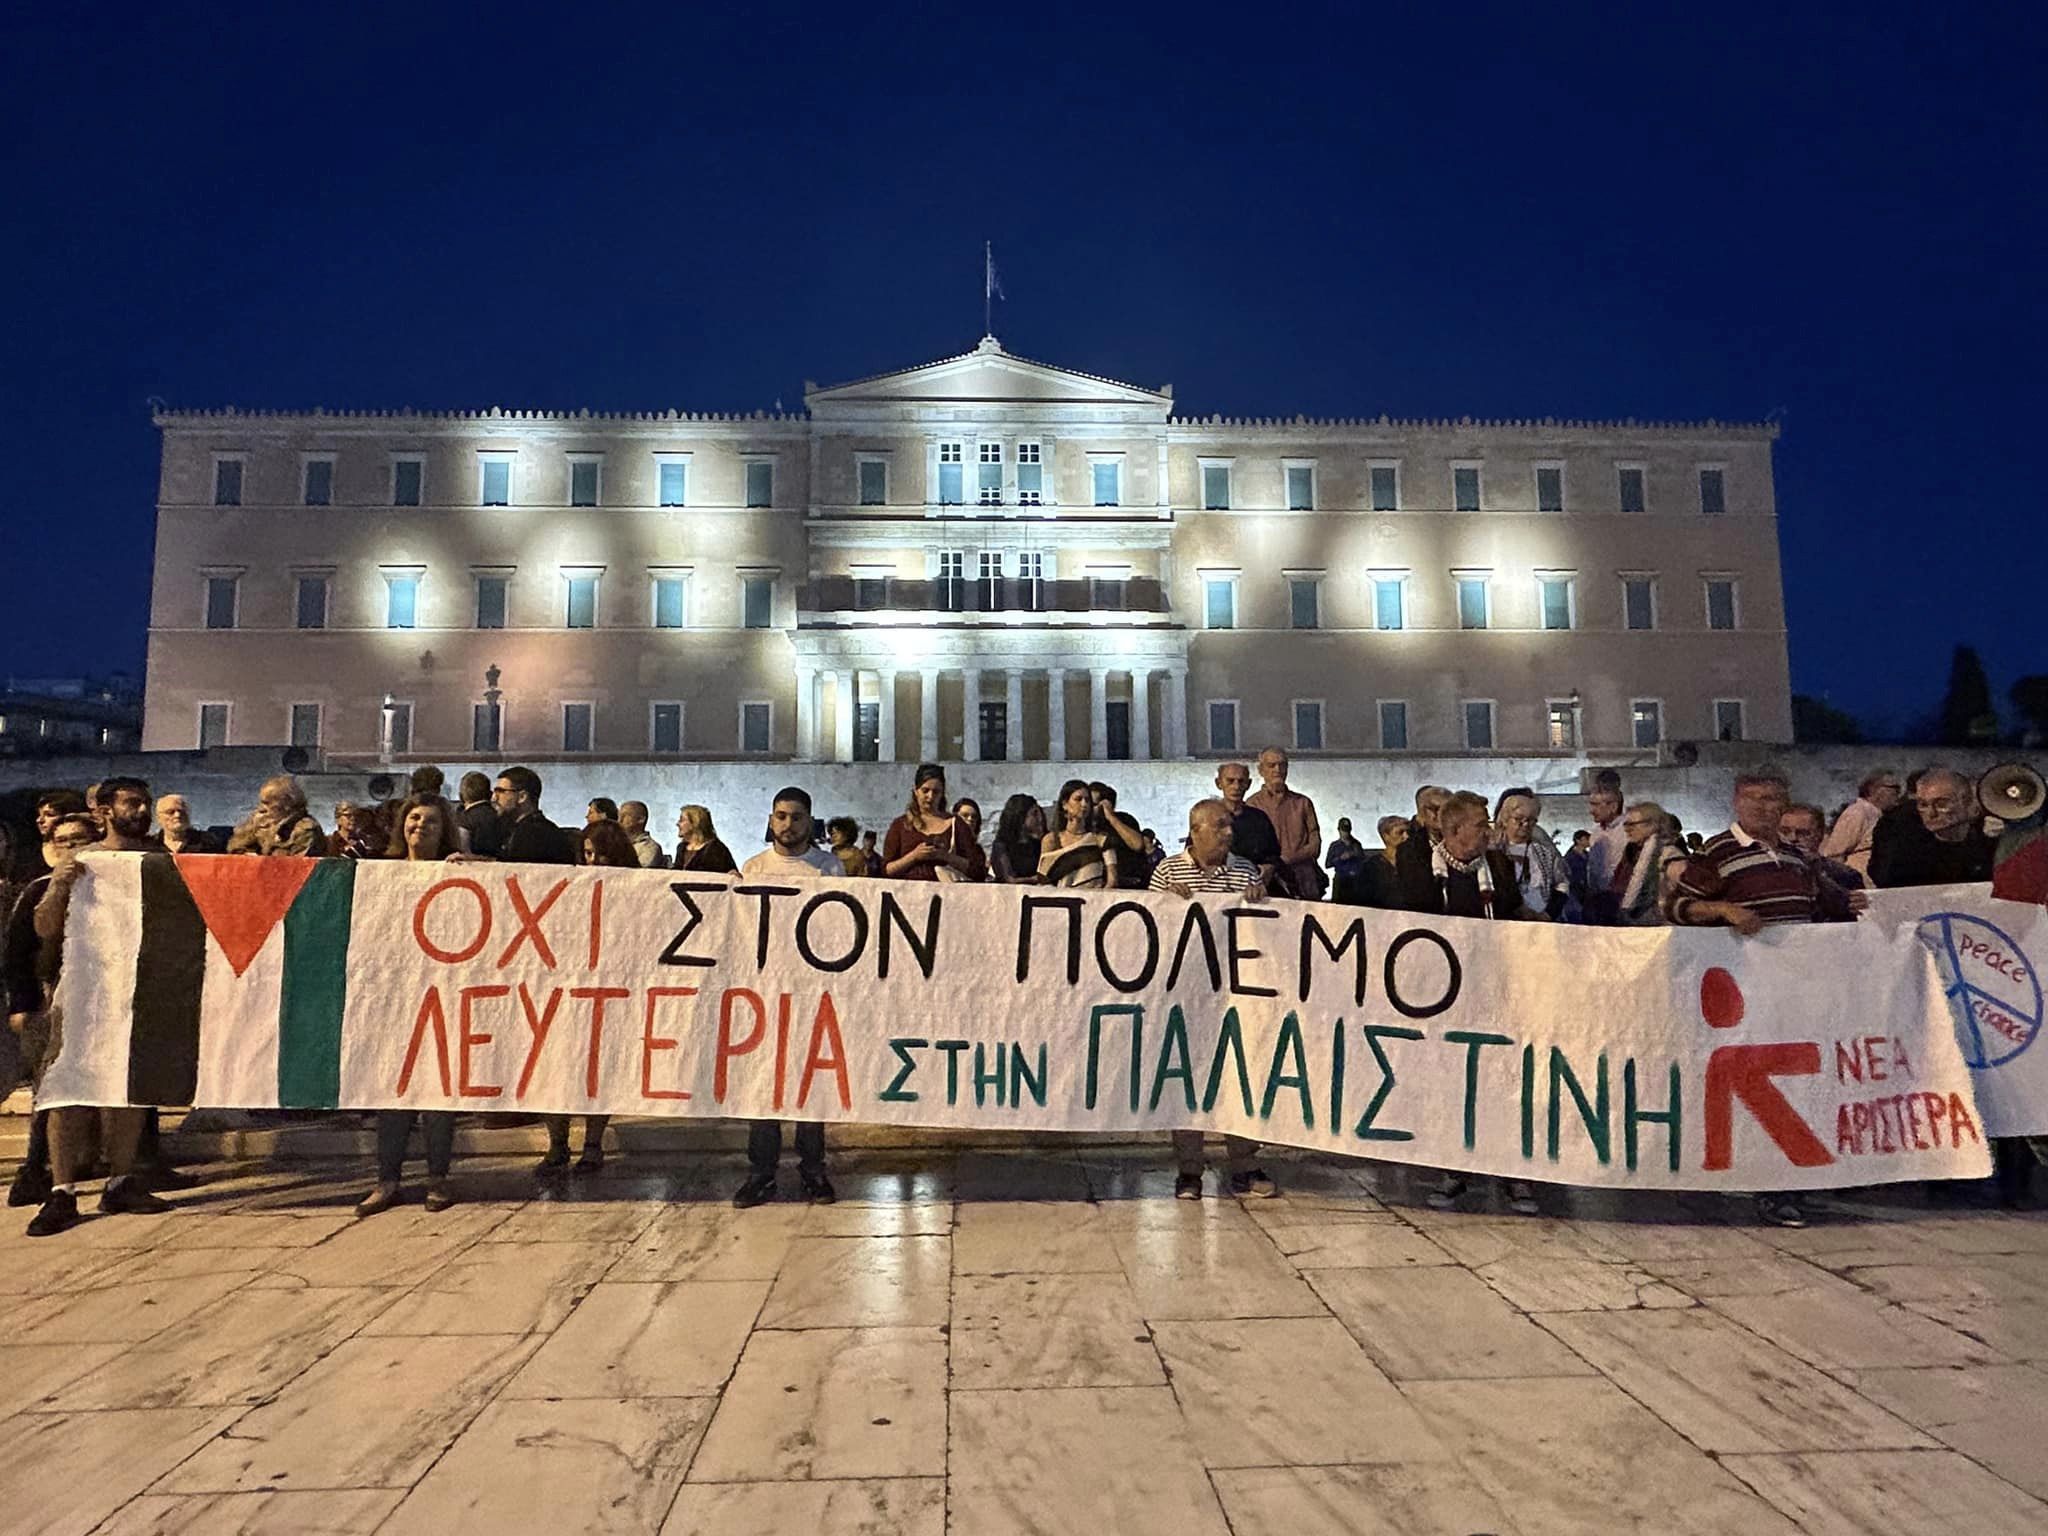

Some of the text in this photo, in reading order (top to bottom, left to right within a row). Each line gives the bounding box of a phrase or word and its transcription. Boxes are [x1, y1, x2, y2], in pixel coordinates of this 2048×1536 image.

[412, 876, 1462, 1020] ΟΧΙ ΣΤΟΝ ΠΟΛΕΜΟ
[396, 981, 1682, 1174] ΛΕΥΤΕΡΙΑ ΣΤΗΝ ΠΑΛΑΙΣΤΙΝΗ
[1834, 1036, 1916, 1086] ΝΕΑ
